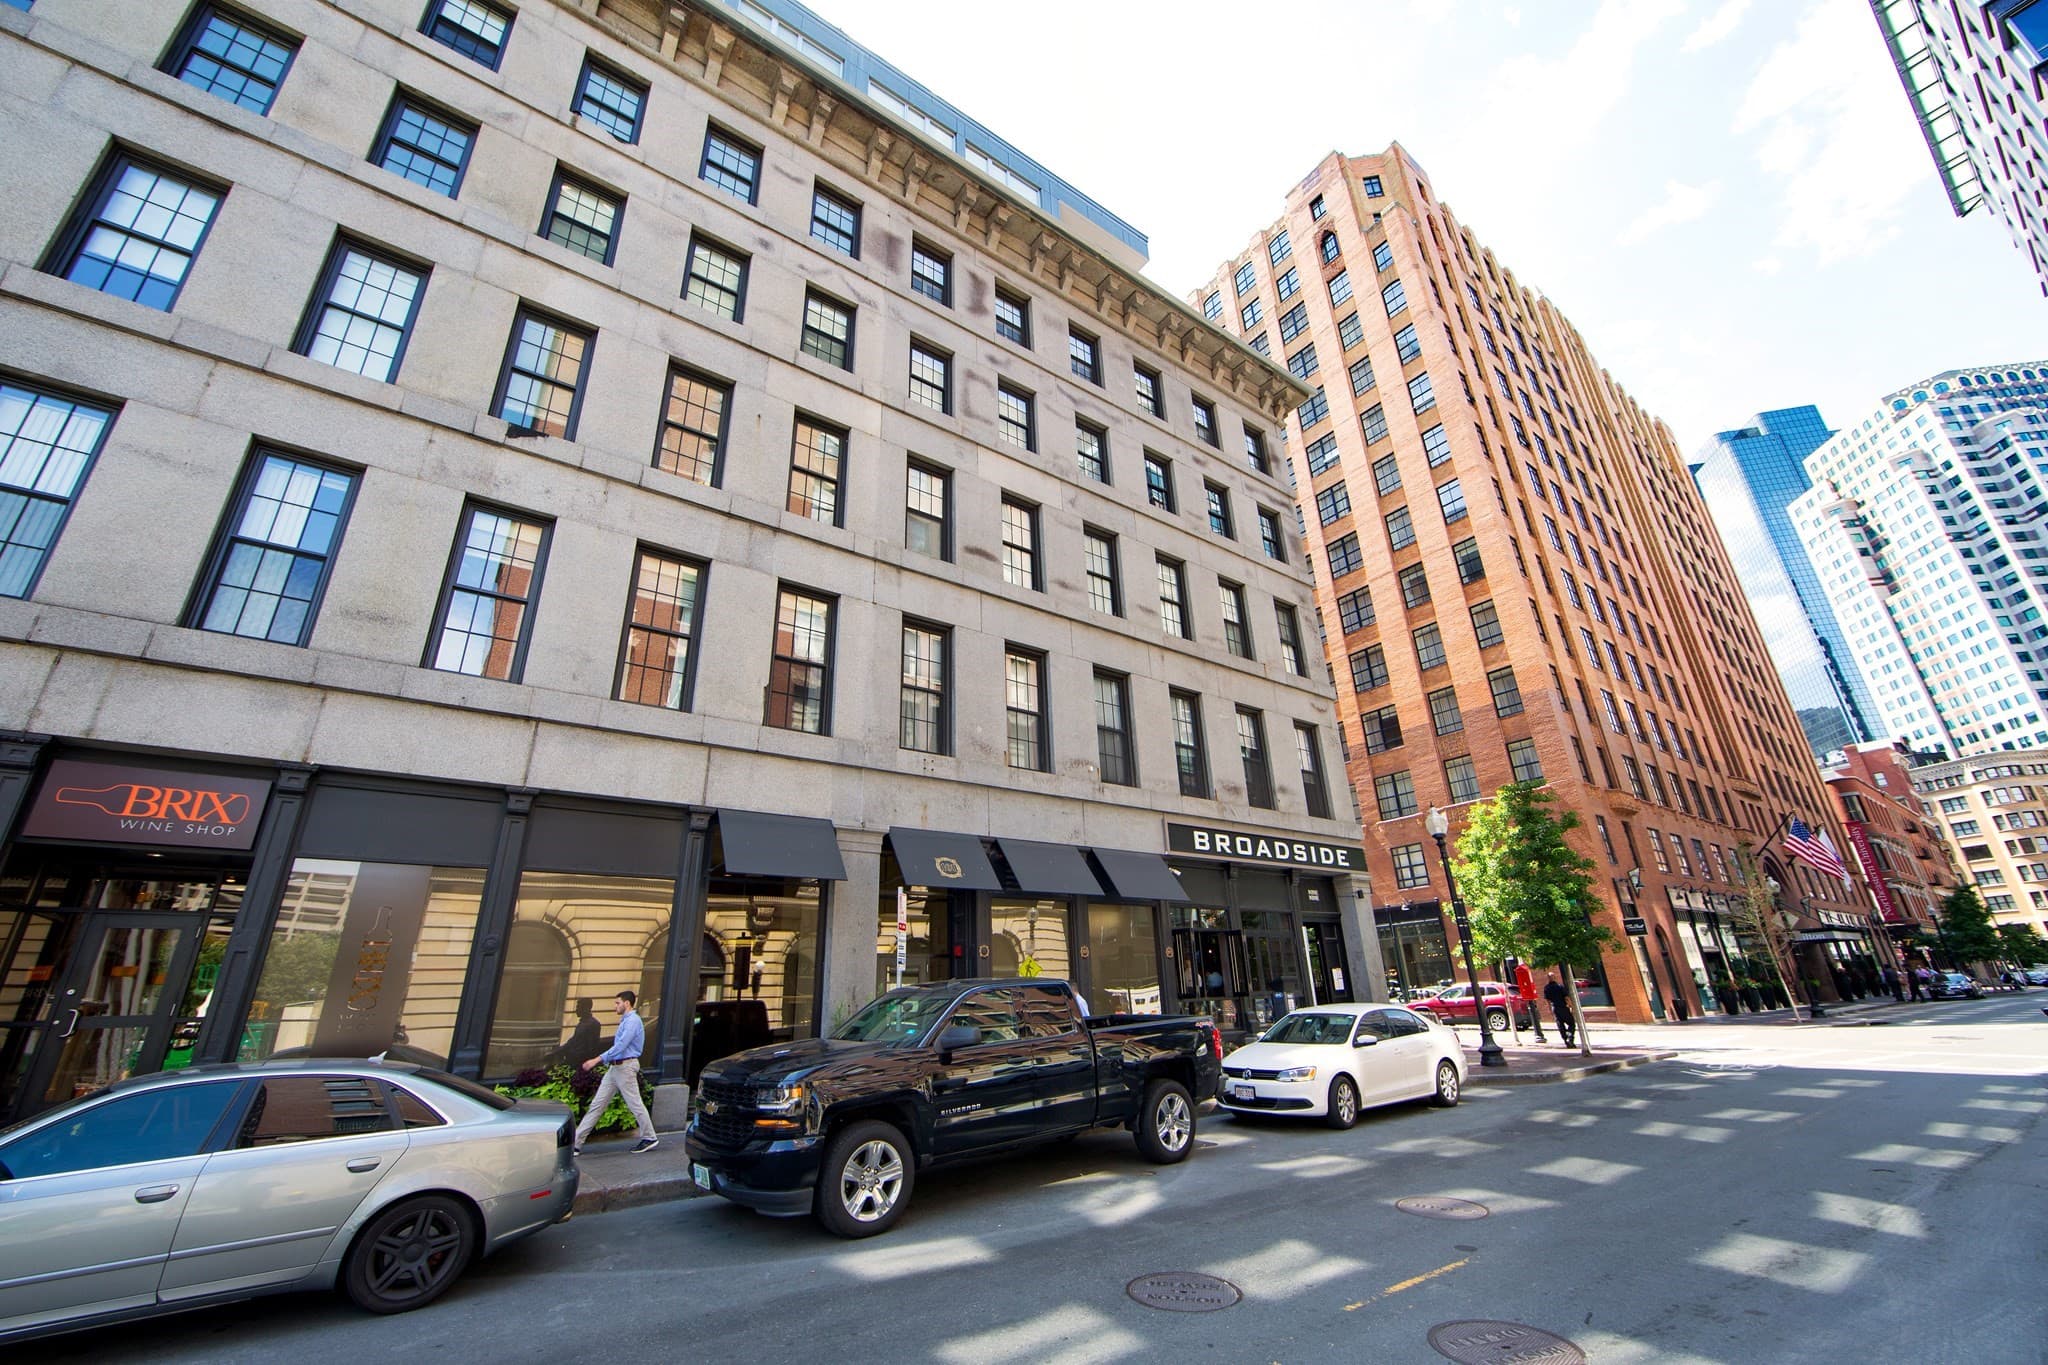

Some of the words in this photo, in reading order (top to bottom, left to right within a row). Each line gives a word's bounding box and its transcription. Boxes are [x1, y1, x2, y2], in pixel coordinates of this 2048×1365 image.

[121, 785, 242, 824] BRIX
[120, 819, 175, 832] WINE
[185, 823, 236, 836] SHOP
[1851, 825, 1871, 865] University
[1193, 830, 1350, 867] BROADSIDE
[1868, 864, 1893, 916] Northeastern
[940, 1103, 981, 1116] SILVERADO
